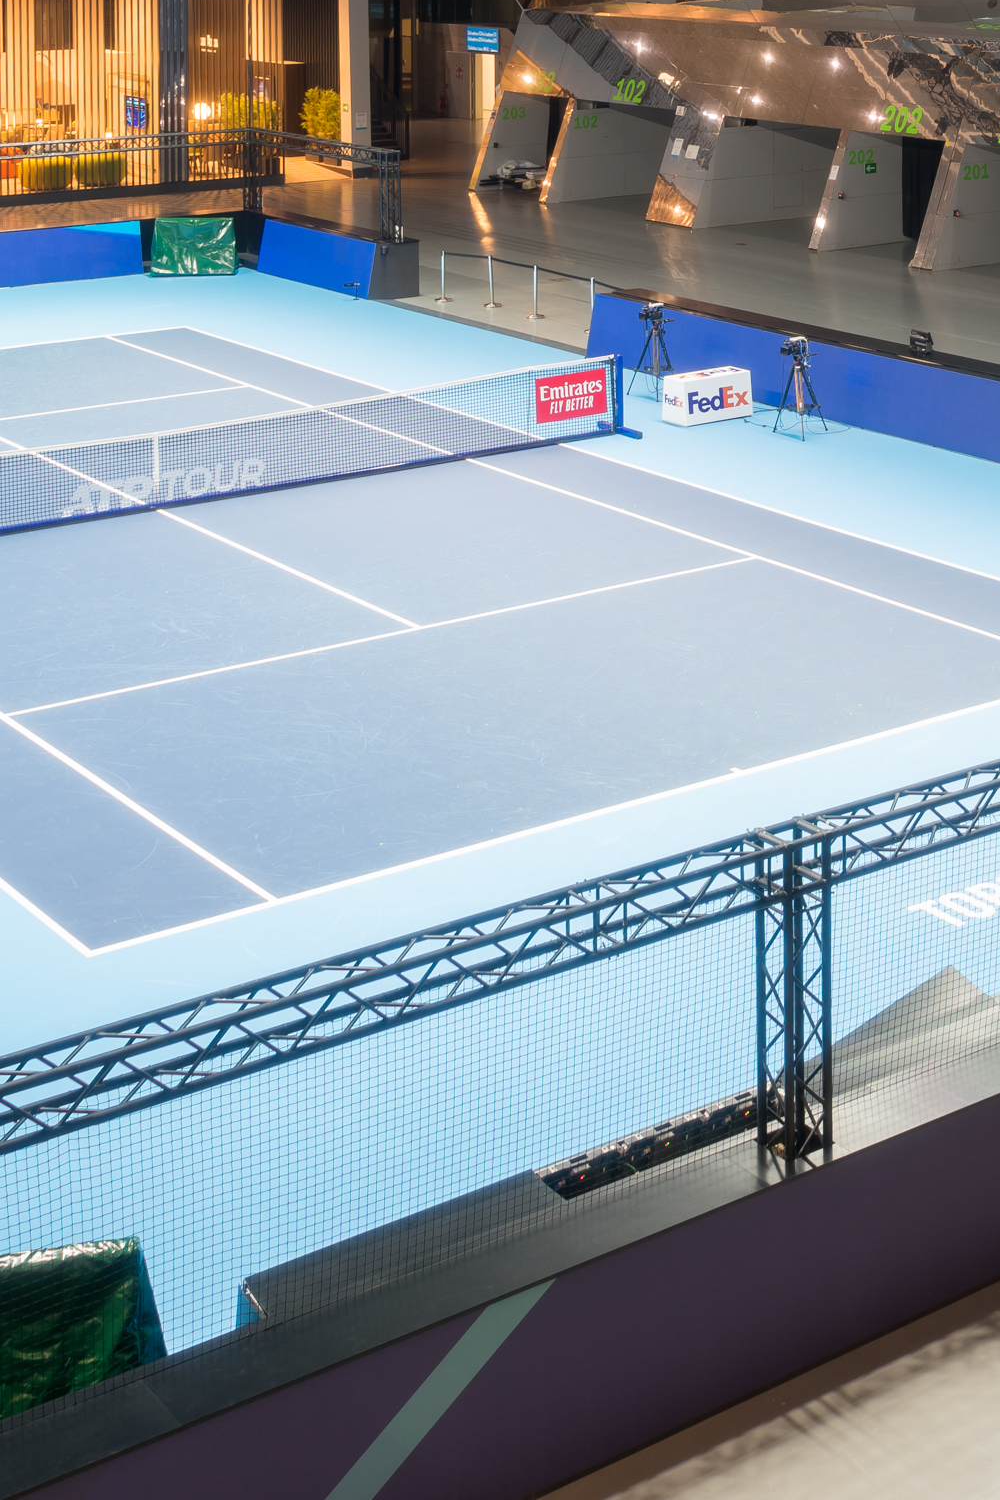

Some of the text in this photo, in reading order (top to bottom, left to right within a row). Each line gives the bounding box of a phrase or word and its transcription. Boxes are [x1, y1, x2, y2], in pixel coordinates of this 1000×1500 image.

[613, 78, 646, 104] 102
[502, 106, 526, 120] 203
[574, 115, 598, 129] 102
[880, 105, 923, 134] 202
[848, 149, 875, 165] 202
[963, 163, 990, 181] 201
[539, 378, 603, 401] Emirates
[549, 395, 594, 415] FLY BETTER
[664, 392, 684, 409] FedEx
[687, 385, 750, 415] FedEx
[60, 458, 266, 519] ATP TOUR
